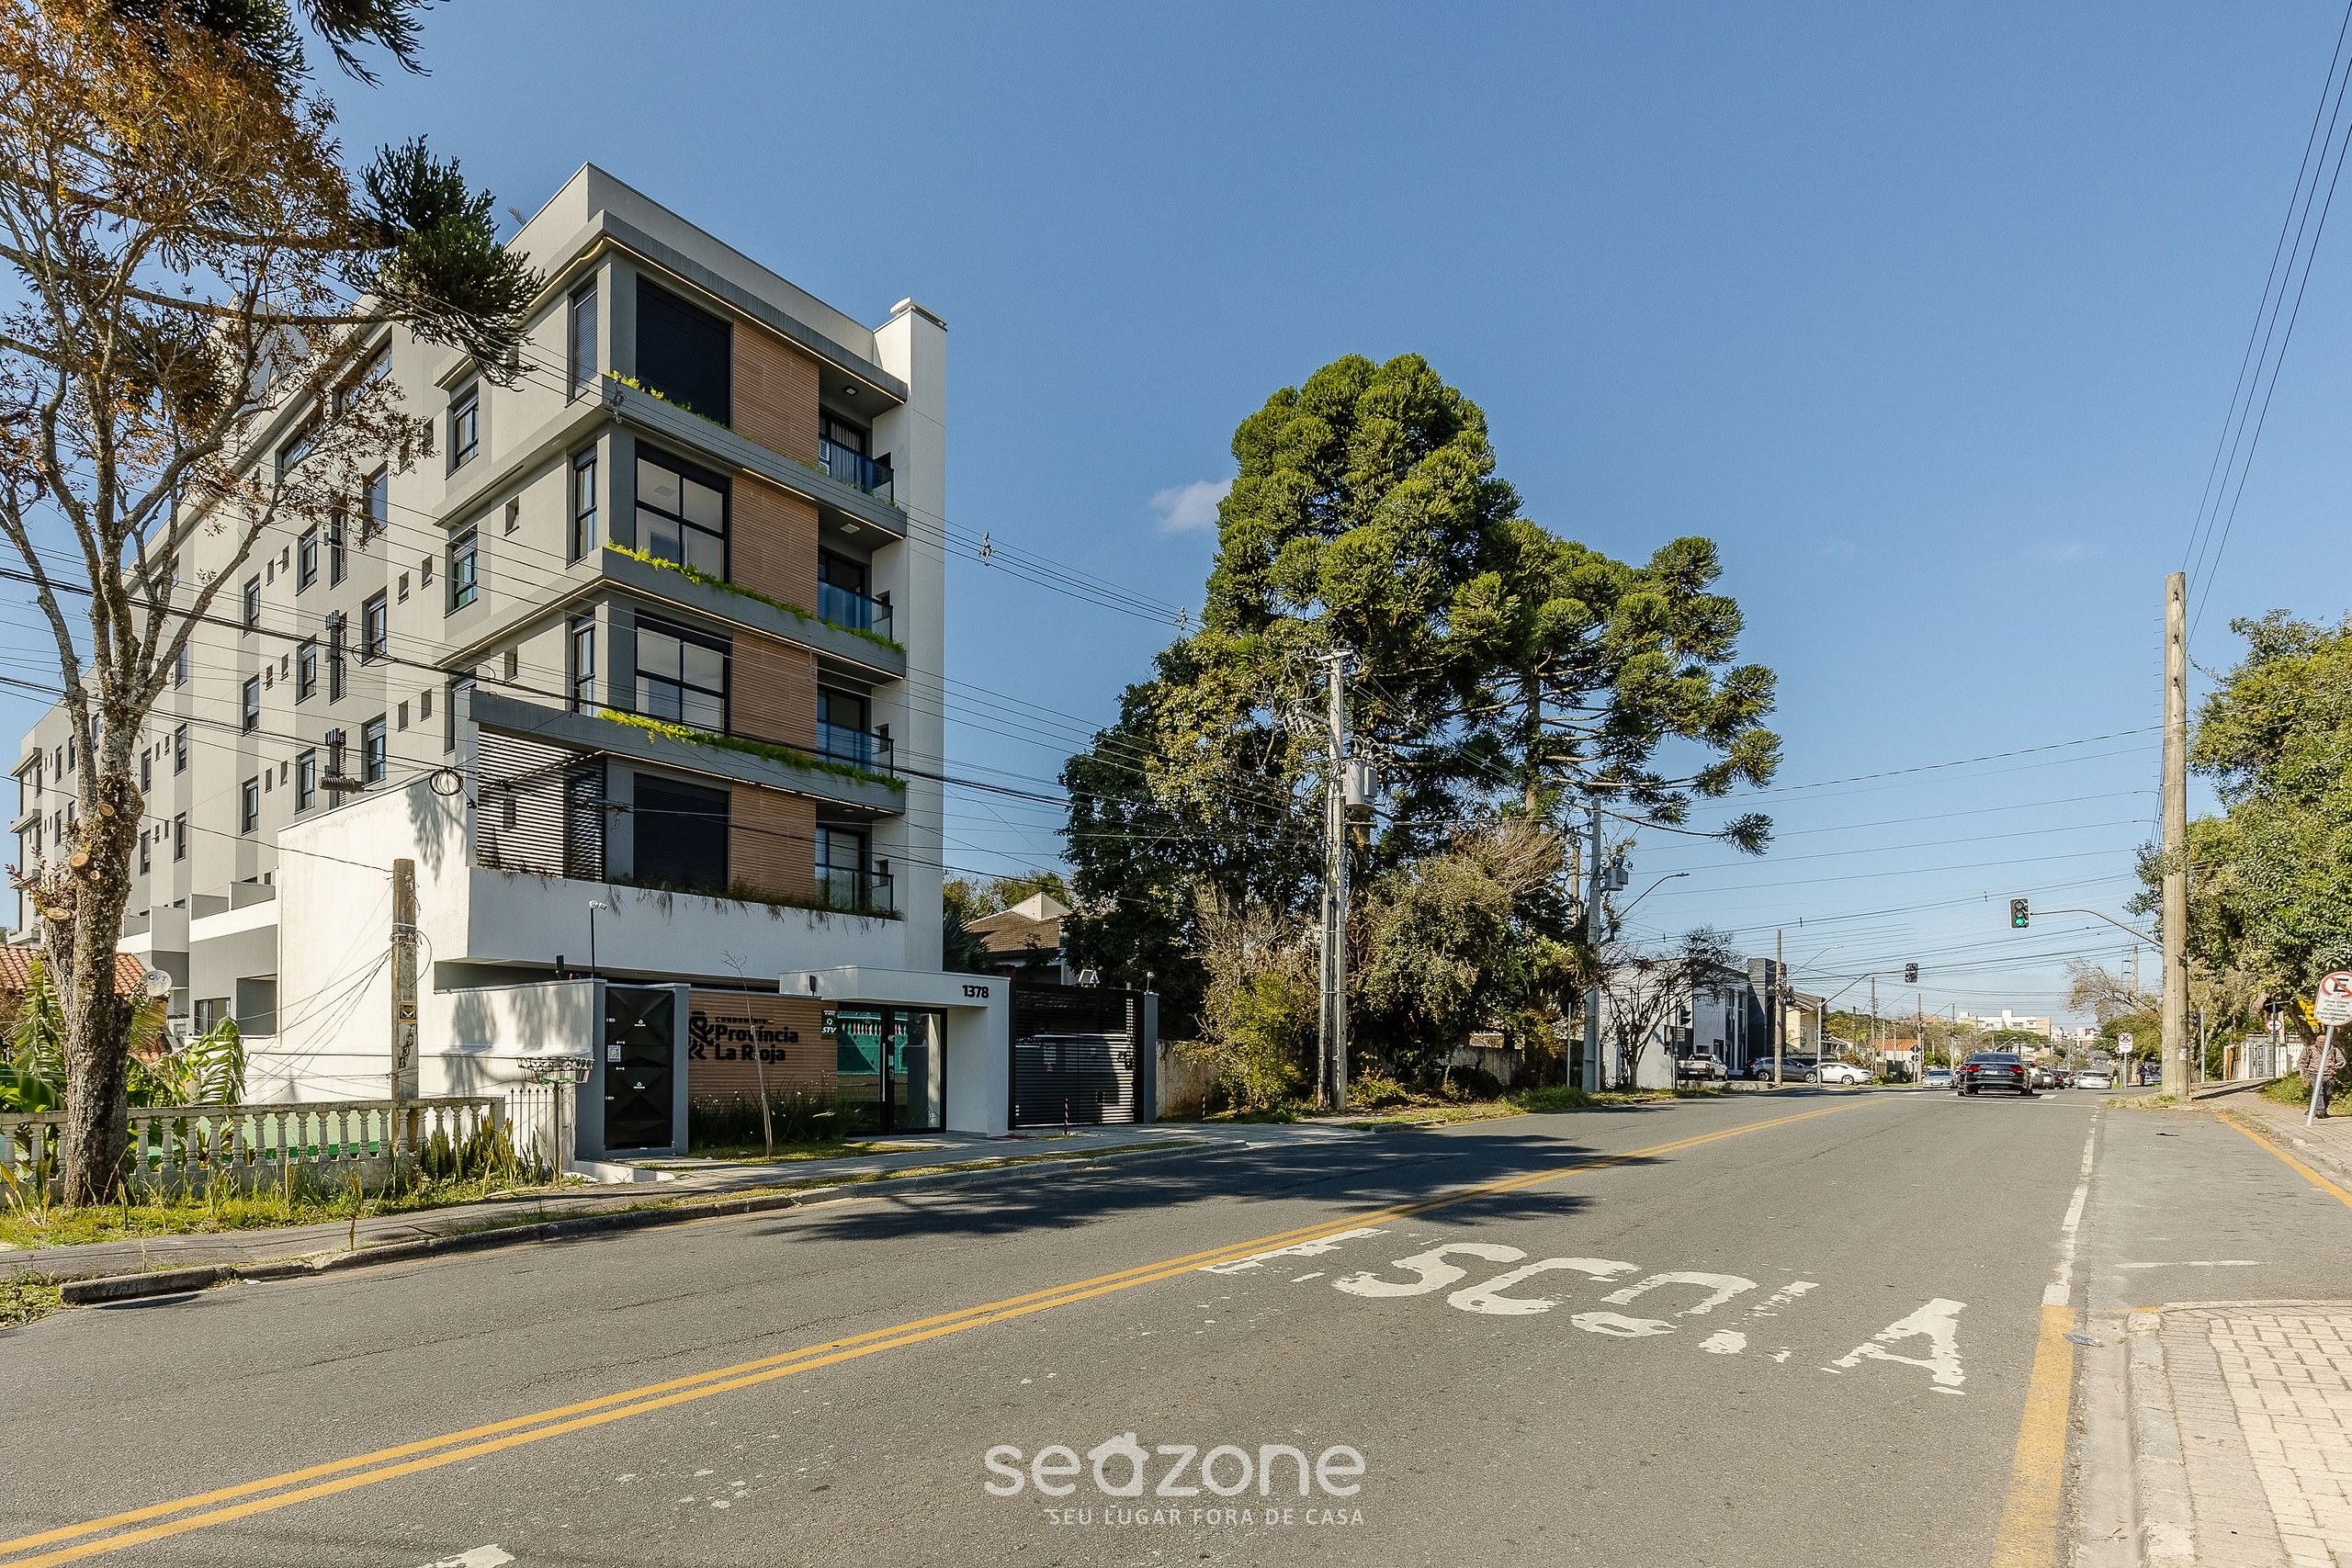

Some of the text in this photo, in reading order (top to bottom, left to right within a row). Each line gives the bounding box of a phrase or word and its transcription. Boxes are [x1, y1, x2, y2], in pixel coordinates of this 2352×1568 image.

[148, 974, 167, 983] GVT
[962, 985, 989, 998] 1378
[715, 1024, 799, 1043] Província
[715, 1043, 786, 1065] La Roja
